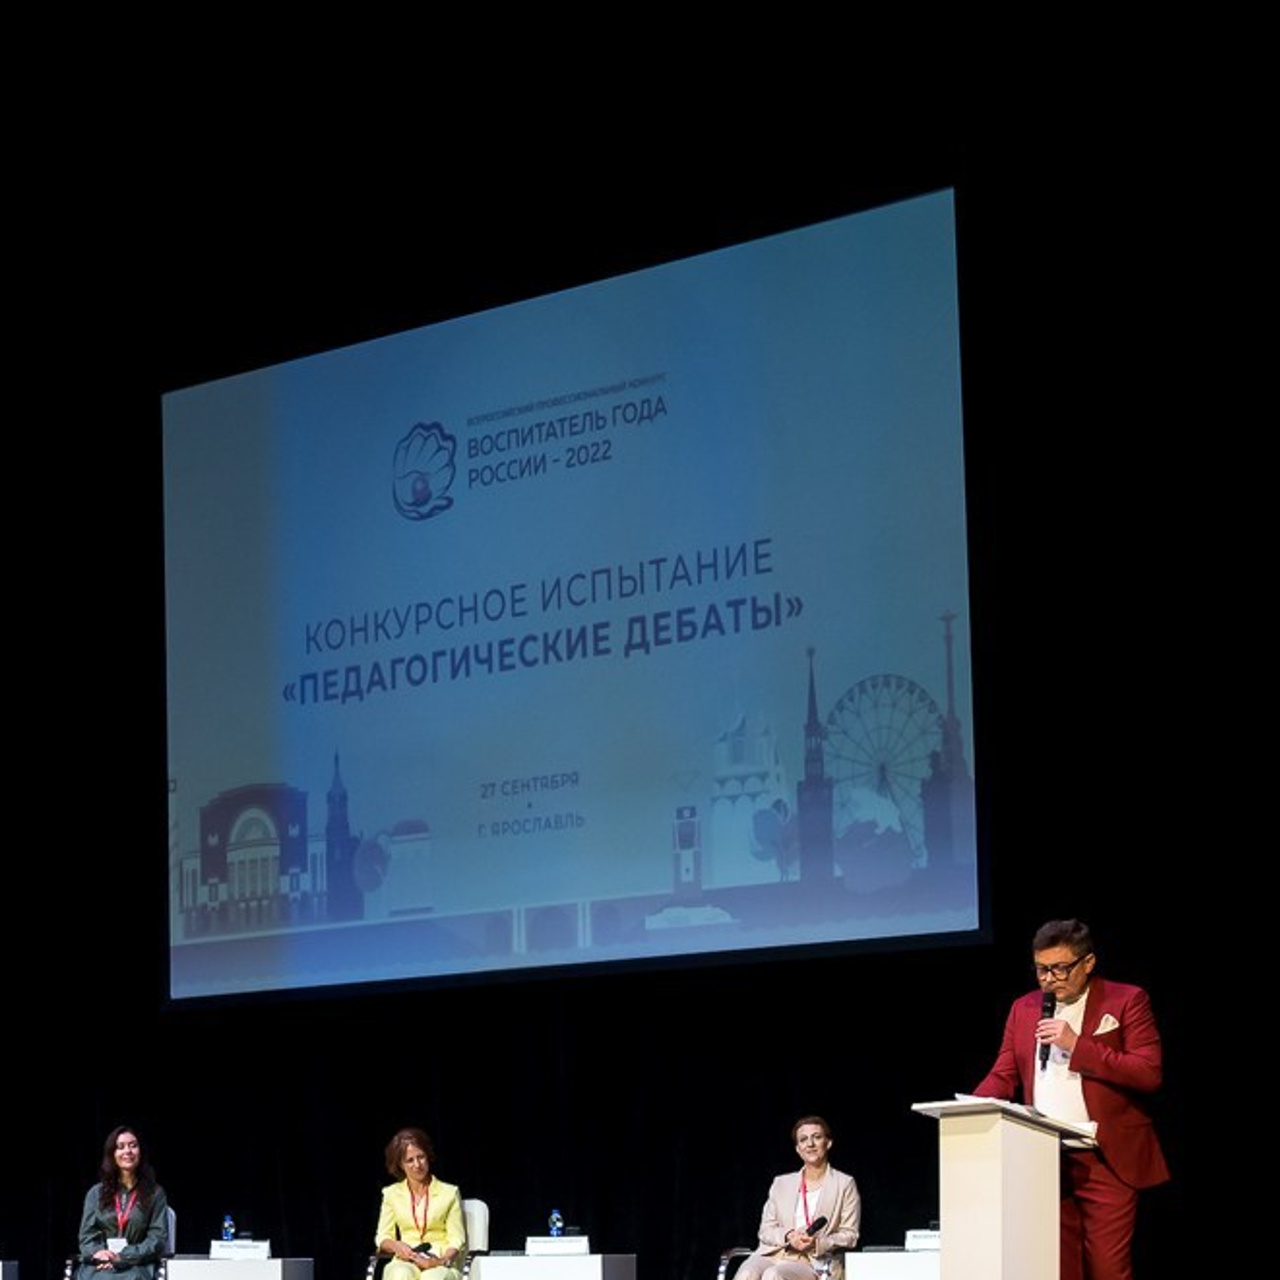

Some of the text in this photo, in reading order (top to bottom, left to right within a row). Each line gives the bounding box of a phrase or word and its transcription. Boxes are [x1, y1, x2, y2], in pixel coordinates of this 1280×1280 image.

[468, 410, 607, 459] ВОСПИТАТЕЛЬ
[612, 395, 668, 427] ГОДА
[468, 453, 547, 489] РОССИИ
[565, 439, 612, 468] 2022
[305, 538, 773, 655] КОНКУРСНОЕ ИСПЫТАНИЕ
[282, 591, 804, 705] «ПЕДАГОГИЧЕСКИЕ ДЕБАТЫ»
[480, 771, 579, 799] 27 СЕНТЯБРЯ
[492, 813, 586, 838] ЯРОСЛАВЛЬ
